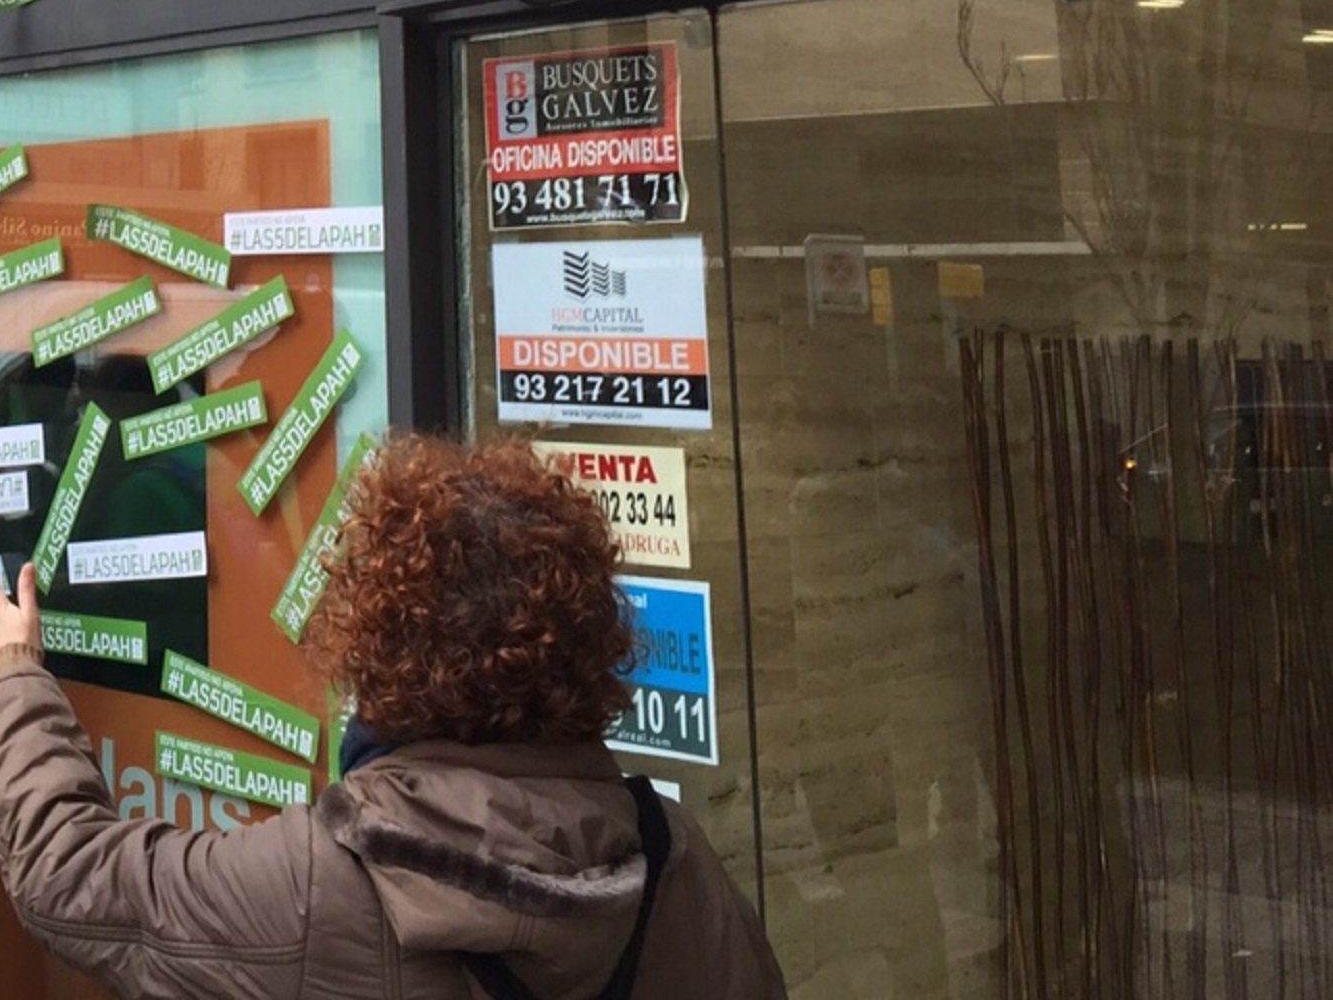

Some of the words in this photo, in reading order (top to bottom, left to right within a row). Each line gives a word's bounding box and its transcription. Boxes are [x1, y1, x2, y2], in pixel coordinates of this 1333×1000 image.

[543, 55, 657, 90] BUSQUETS
[542, 86, 658, 119] GALVEZ
[492, 143, 562, 173] OFICINA
[567, 134, 676, 167] DISPONIBLE
[494, 181, 527, 214] 93
[535, 177, 586, 210] 481
[598, 175, 630, 207] 71
[644, 173, 678, 205] 71
[95, 218, 219, 283] #LAS5DELAPAH
[230, 224, 365, 250] #LAS5DELAPAH
[38, 294, 145, 362] #LAS5DELAPAH
[157, 299, 277, 386] #LAS5DELAPAH
[513, 340, 691, 370] DISPONIBLE
[514, 373, 546, 400] 93
[554, 375, 604, 402] 217
[613, 377, 644, 404] 21
[657, 378, 691, 406] 12
[128, 399, 248, 453] #LAS5DELAPAH
[250, 356, 352, 507] #LAS5DELAPAH
[38, 430, 103, 585] #LAS5DELAPAH
[627, 492, 648, 525] 33
[654, 494, 676, 527] 44
[73, 551, 191, 580] #LAS5DELAPAH
[168, 669, 299, 750] #LAS5DELAPAH
[633, 688, 664, 734] 10
[675, 694, 705, 743] 11
[160, 748, 293, 804] #LAS5DELAPAH
